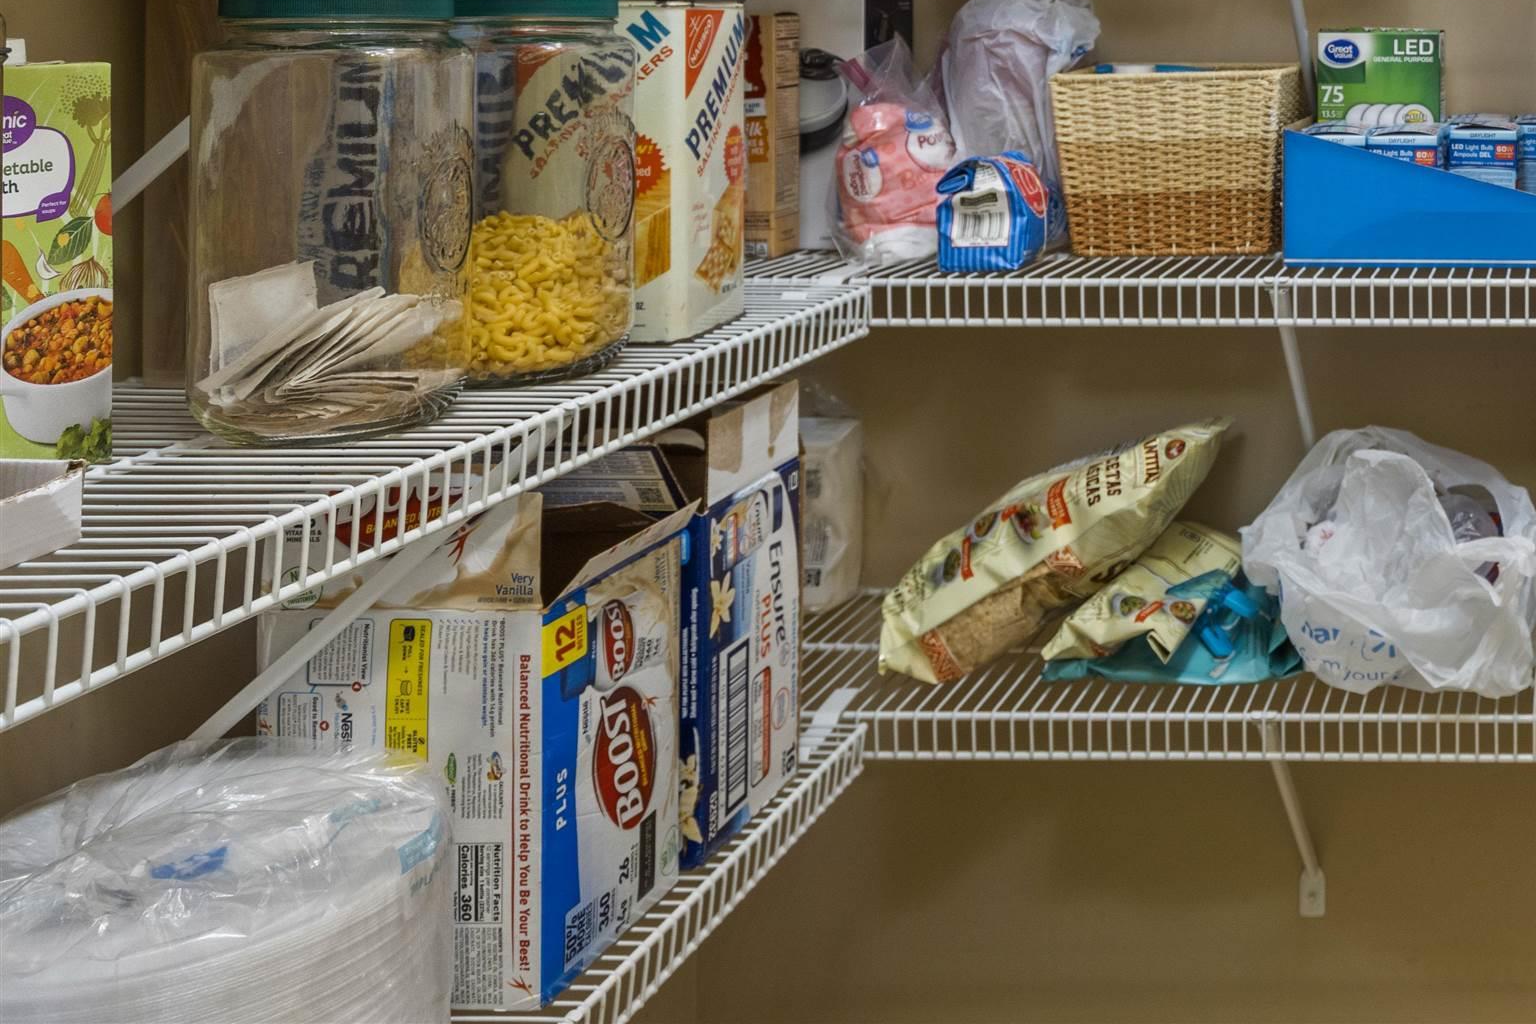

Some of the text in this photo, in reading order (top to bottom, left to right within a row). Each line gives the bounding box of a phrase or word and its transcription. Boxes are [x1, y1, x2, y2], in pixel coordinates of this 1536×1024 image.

[1327, 44, 1353, 55] Great
[1393, 38, 1434, 56] LED
[684, 12, 745, 161] PREMIUM
[1320, 85, 1345, 104] 75
[1321, 110, 1336, 118] 13.5
[697, 119, 723, 176] SALTINE
[1415, 150, 1435, 159] 60W
[1465, 144, 1479, 152] Light
[1480, 144, 1494, 152] Bulb
[1495, 144, 1515, 154] 60W
[495, 584, 535, 597] Vanilla
[511, 572, 535, 586] Very
[769, 539, 786, 648] Ensure
[361, 623, 370, 661] Nutritionist
[555, 618, 577, 664] 12
[576, 614, 584, 651] BOTTLES
[603, 601, 626, 682] BOOST
[760, 591, 771, 660] PLUS
[600, 695, 645, 824] BOOST
[785, 741, 796, 774] 16
[518, 653, 532, 972] Balanced Nutritional Drink to Help You Be Your Best!
[556, 768, 568, 831] PLUS
[461, 845, 472, 922] Calories 360
[493, 844, 501, 922] Nutrition Facts
[618, 856, 630, 885] 26
[576, 907, 587, 953] MORE
[598, 891, 611, 934] 360
[565, 913, 578, 963] 50%
